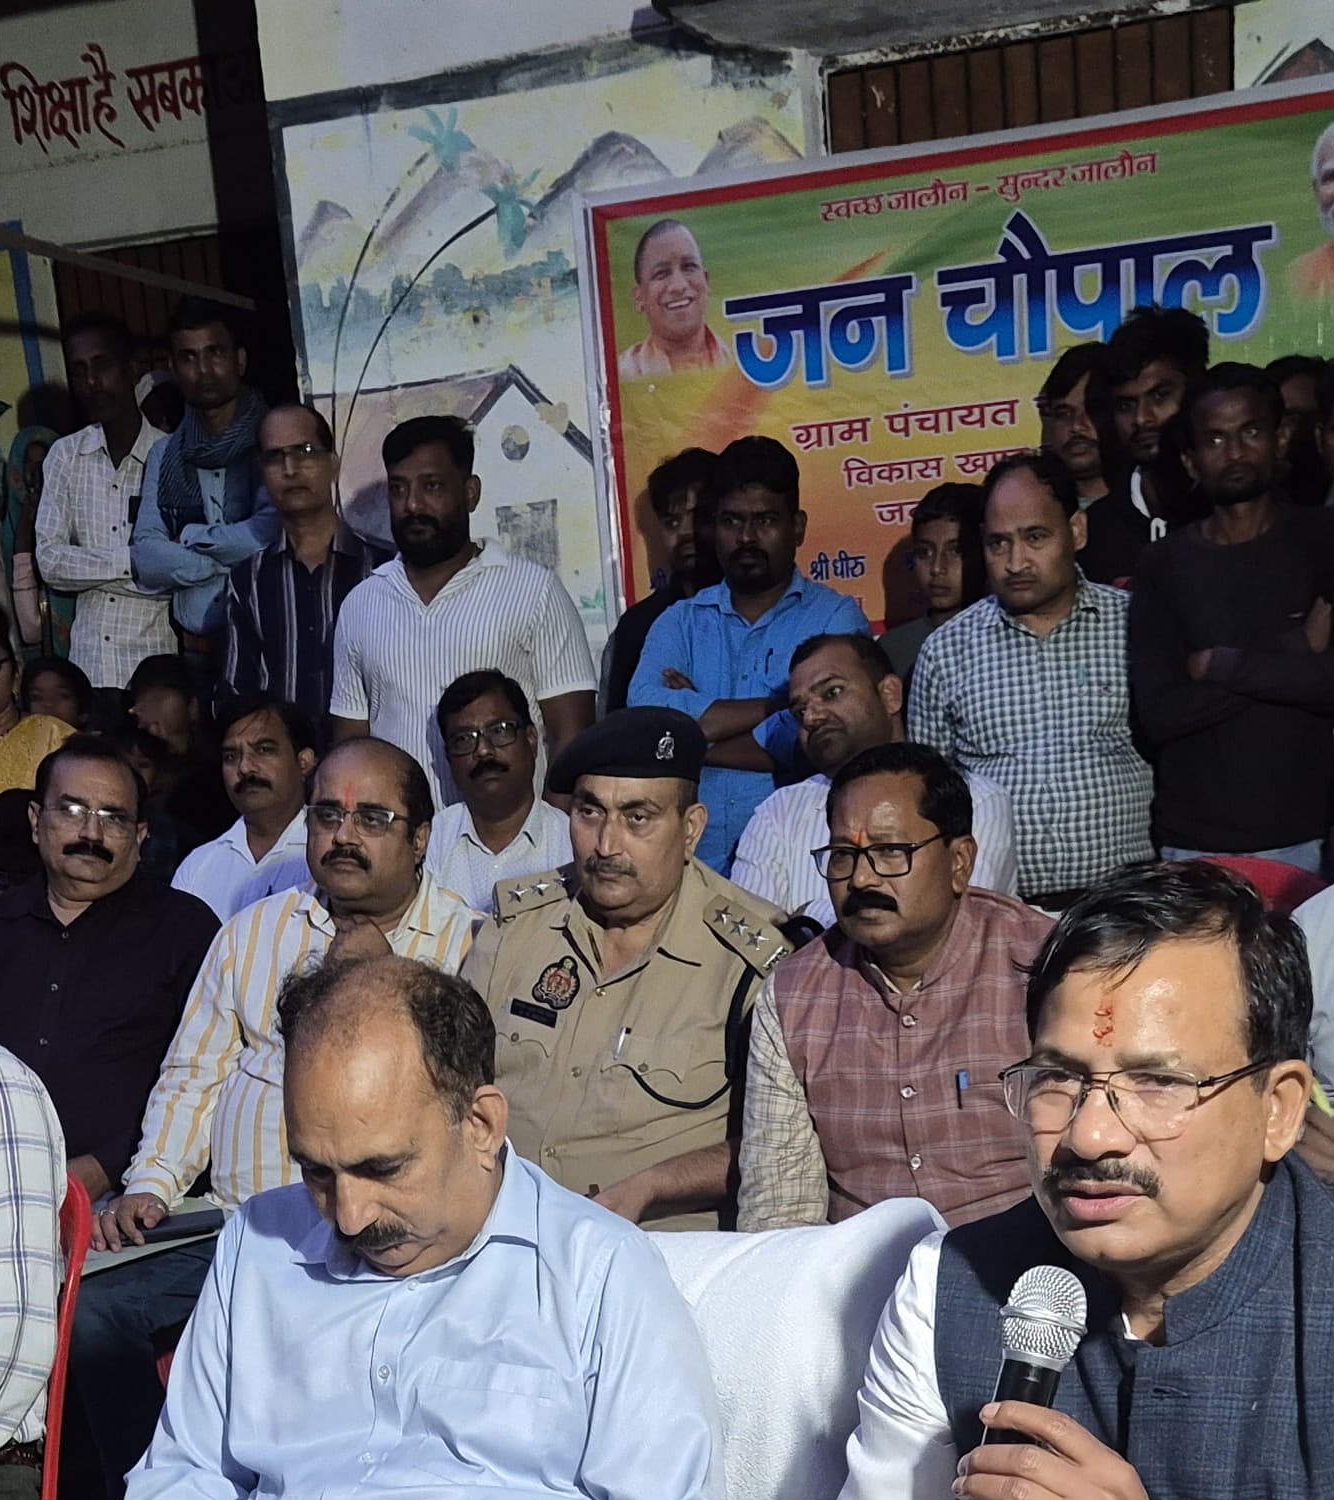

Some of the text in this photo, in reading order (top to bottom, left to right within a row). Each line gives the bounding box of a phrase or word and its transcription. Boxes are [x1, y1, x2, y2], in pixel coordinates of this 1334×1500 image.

[821, 195, 883, 223] स्वच्छ
[887, 177, 968, 214] जालौन
[995, 168, 1068, 201] सुन्दर
[1071, 150, 1158, 185] जालौन
[725, 208, 1275, 387] जन चौपाल
[793, 417, 871, 451] ग्राम
[884, 402, 1019, 438] पंचायत
[843, 457, 944, 488] विकास
[810, 551, 830, 581] श्री
